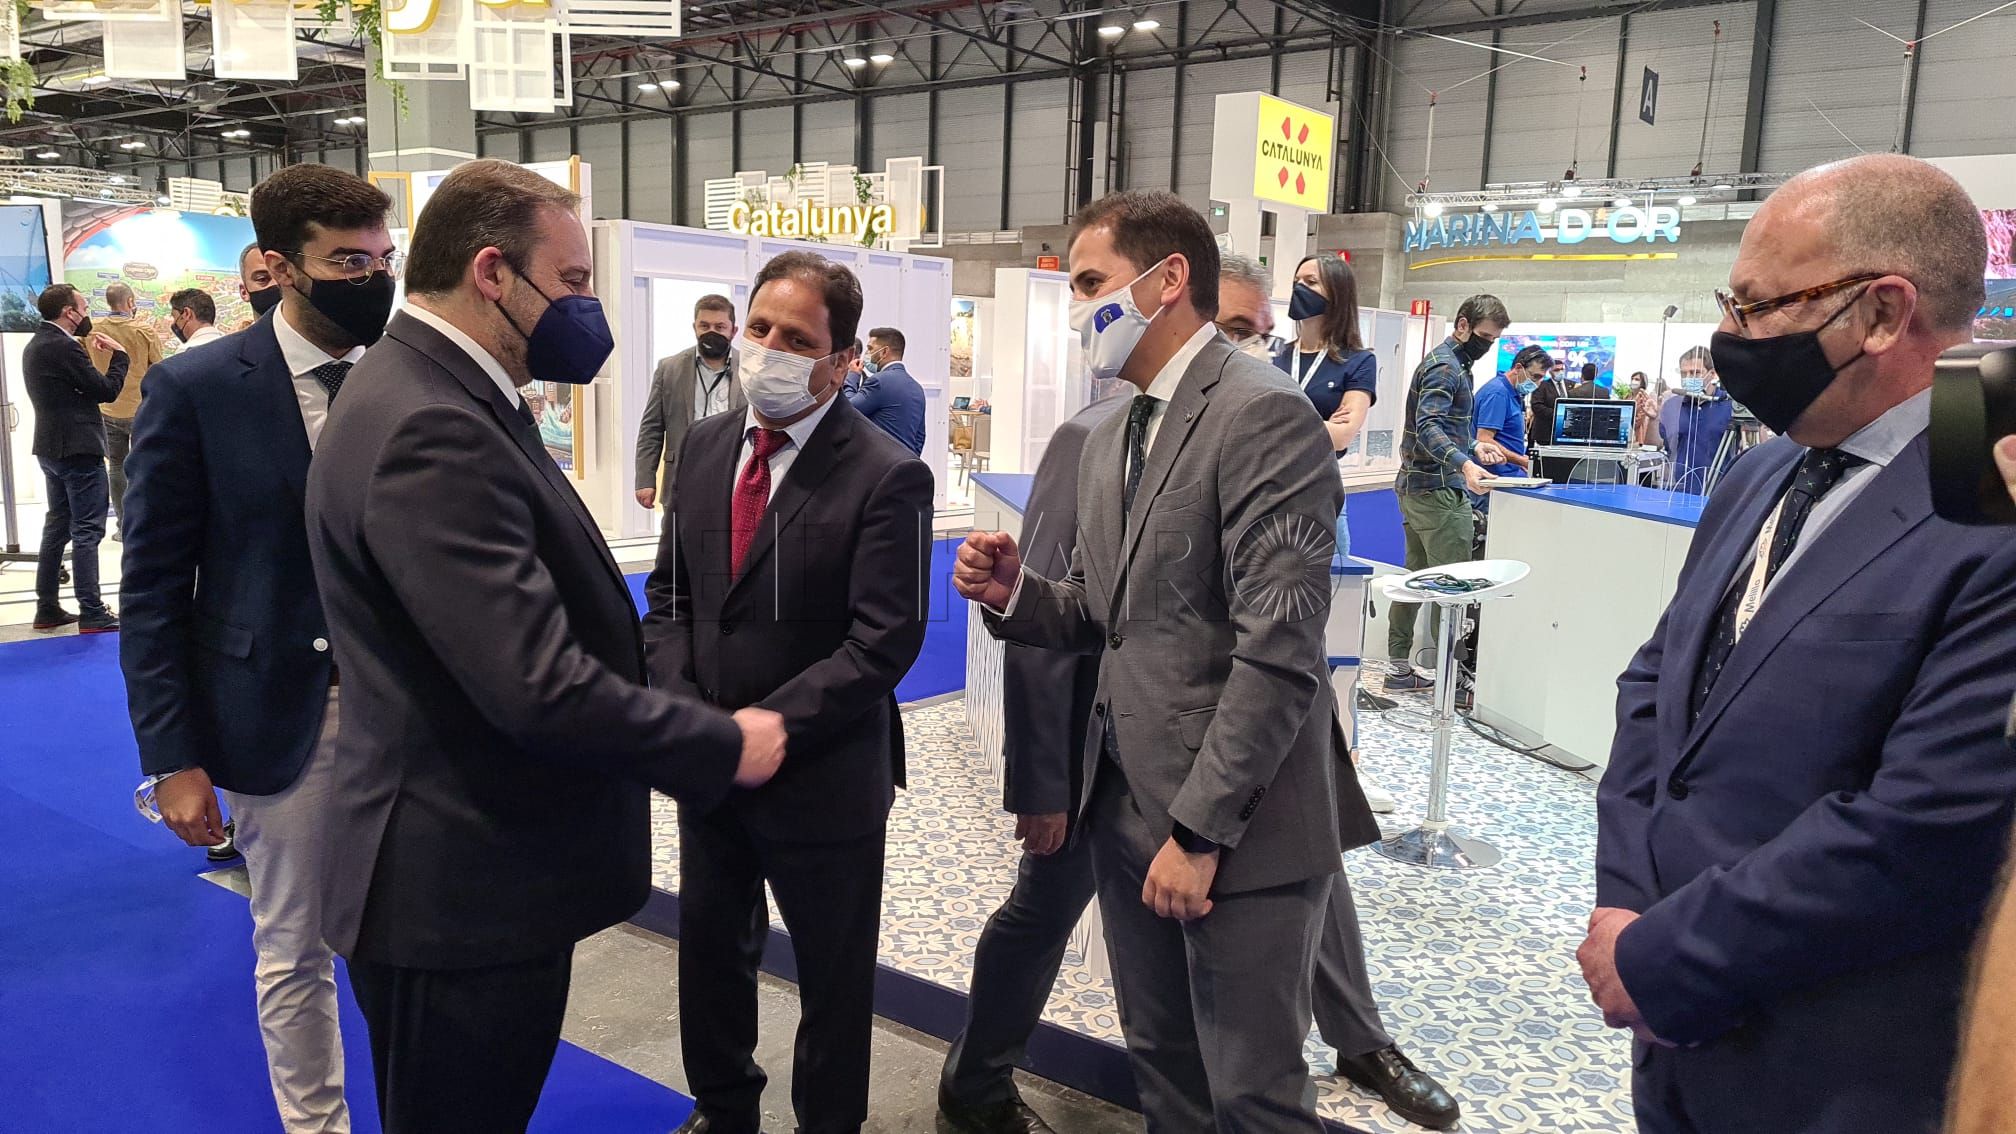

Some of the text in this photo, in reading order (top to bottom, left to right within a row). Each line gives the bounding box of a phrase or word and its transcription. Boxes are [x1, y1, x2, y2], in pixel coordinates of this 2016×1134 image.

[1642, 79, 1653, 117] A
[1261, 139, 1323, 171] CATALUNYA
[727, 199, 896, 242] Catalunya
[1403, 208, 1545, 252] MARINA
